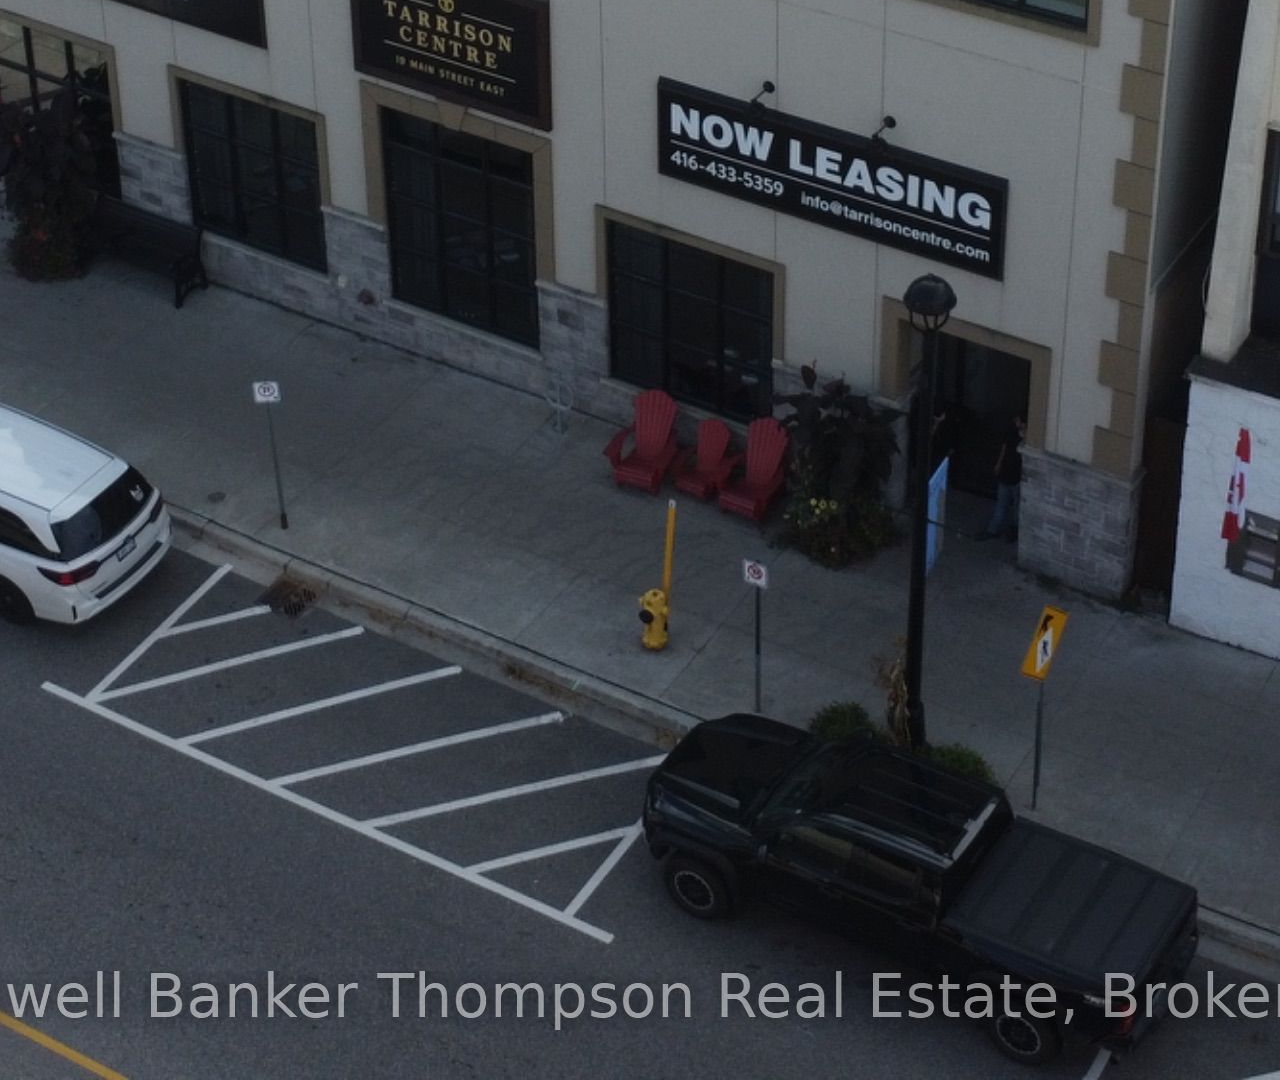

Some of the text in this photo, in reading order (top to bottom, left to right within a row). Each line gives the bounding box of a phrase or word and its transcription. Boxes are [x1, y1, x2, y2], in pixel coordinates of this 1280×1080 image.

[399, 24, 499, 70] CENTRE
[409, 58, 436, 76] MAIN
[438, 67, 476, 88] STREET
[479, 80, 506, 98] EAST
[669, 102, 992, 232] NOW LEASING
[669, 149, 786, 198] 416-433-5359
[800, 190, 991, 263] info@tarrisoncentre.com
